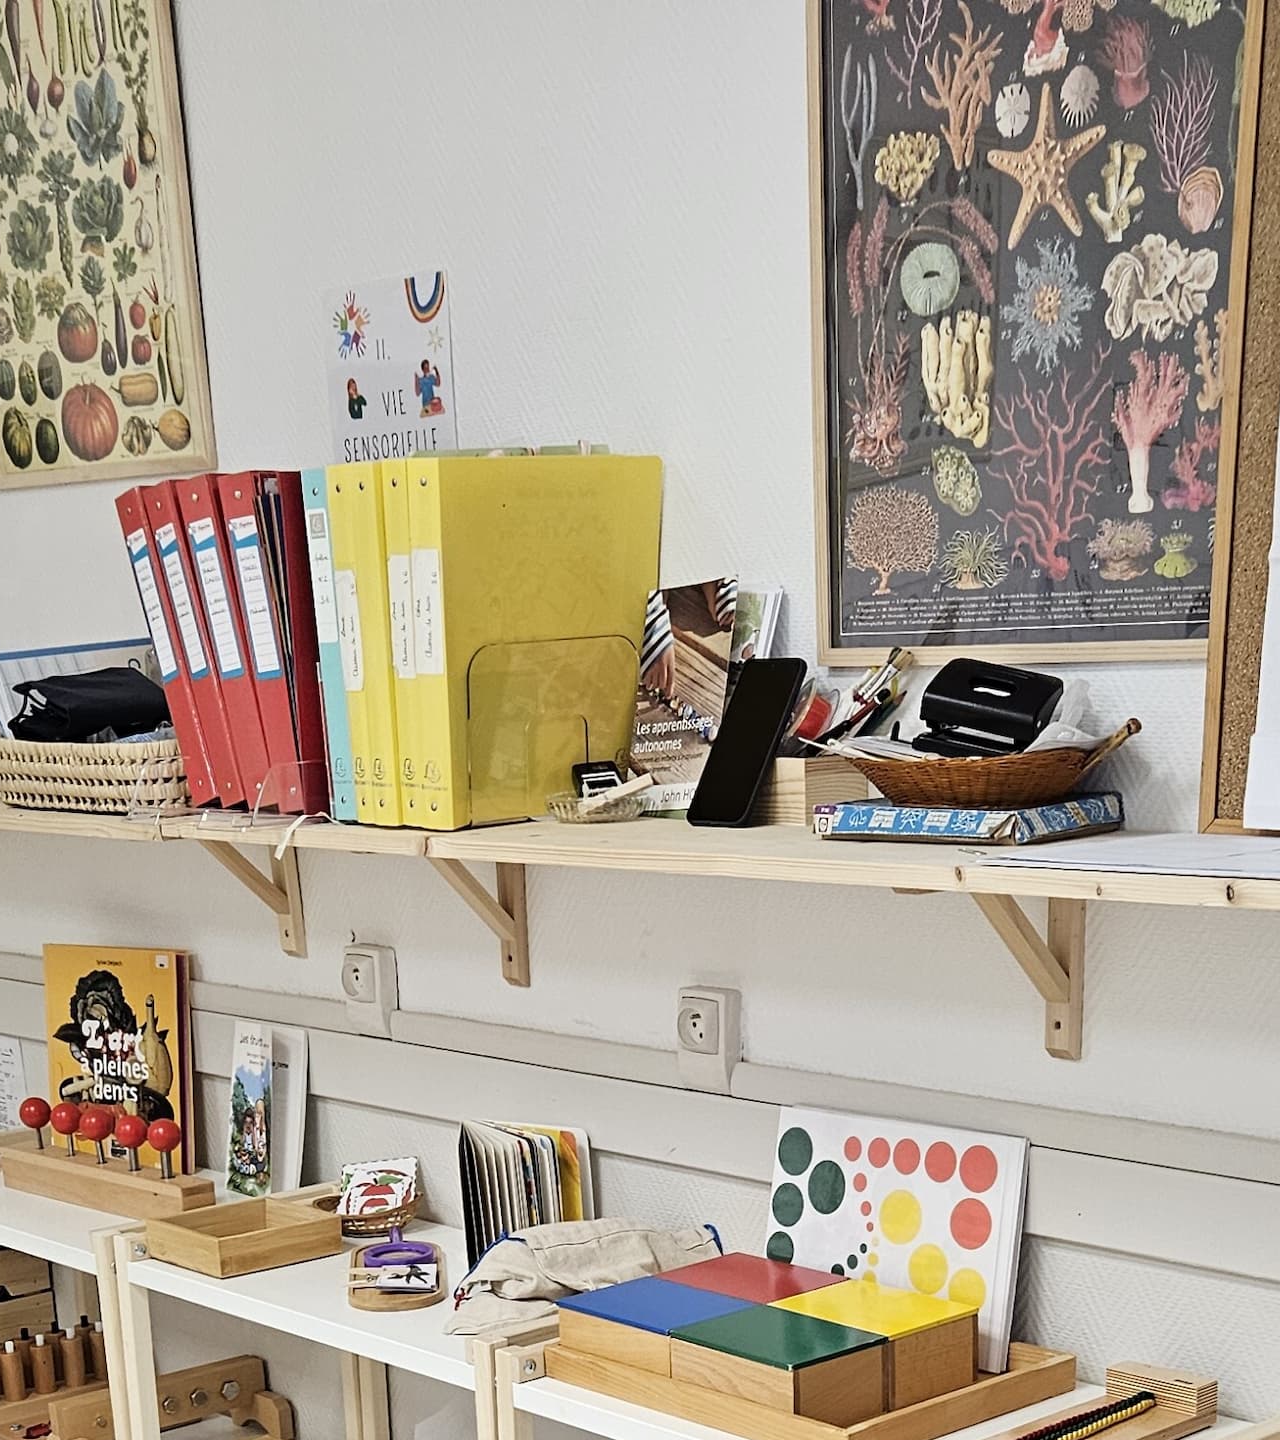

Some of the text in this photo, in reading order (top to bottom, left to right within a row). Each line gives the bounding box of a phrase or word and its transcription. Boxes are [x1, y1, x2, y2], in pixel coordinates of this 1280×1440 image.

[382, 389, 407, 417] VIE
[637, 716, 713, 737] Les apprentissages
[634, 739, 682, 753] autonomes
[661, 790, 681, 803] John
[82, 1019, 146, 1063] L'art
[80, 1049, 150, 1084] à pleines
[94, 1078, 138, 1102] dents
